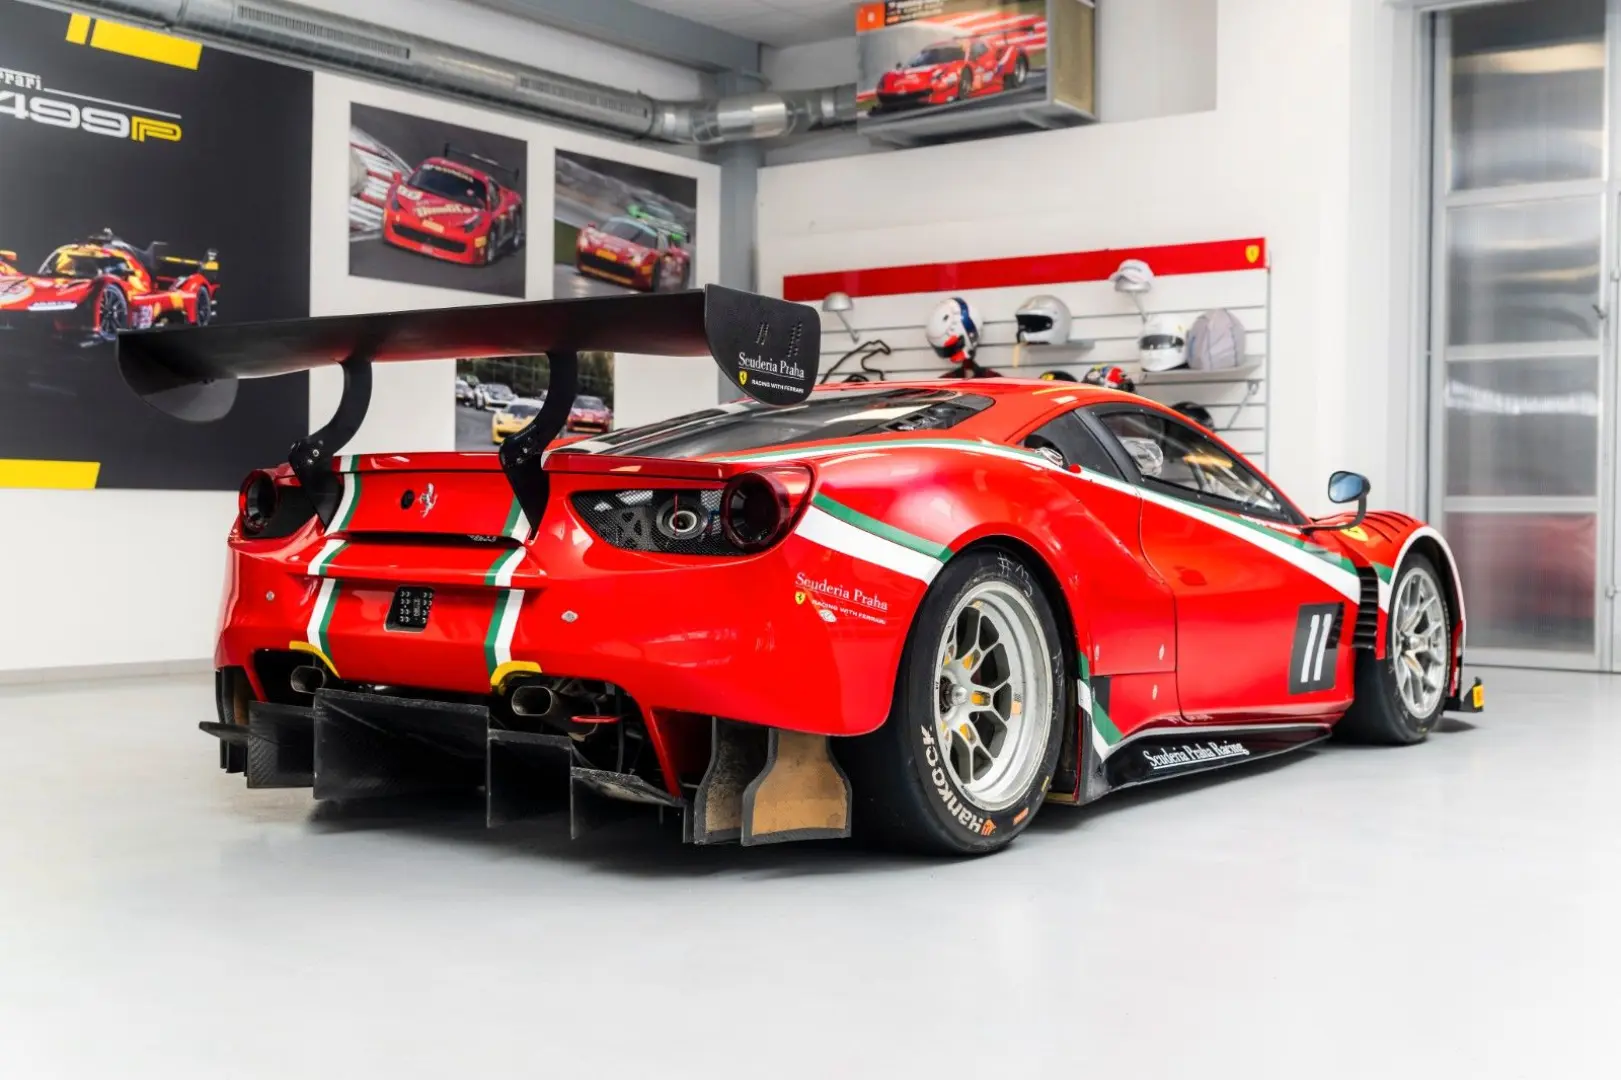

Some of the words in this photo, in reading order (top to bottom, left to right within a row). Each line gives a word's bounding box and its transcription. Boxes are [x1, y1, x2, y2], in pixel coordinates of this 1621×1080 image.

[738, 351, 778, 373] Scuderia
[780, 360, 805, 378] Praha
[751, 379, 771, 388] RACING
[771, 382, 784, 390] WITH
[784, 385, 804, 394] FERRARI
[795, 571, 850, 600] Scuderia
[853, 587, 888, 610] Praha
[811, 599, 839, 611] RACING
[839, 606, 858, 617] WITH
[1300, 613, 1332, 683] 11
[1143, 747, 1190, 767] Scuderia
[1182, 743, 1217, 761] Praha
[1207, 740, 1250, 756] Racing
